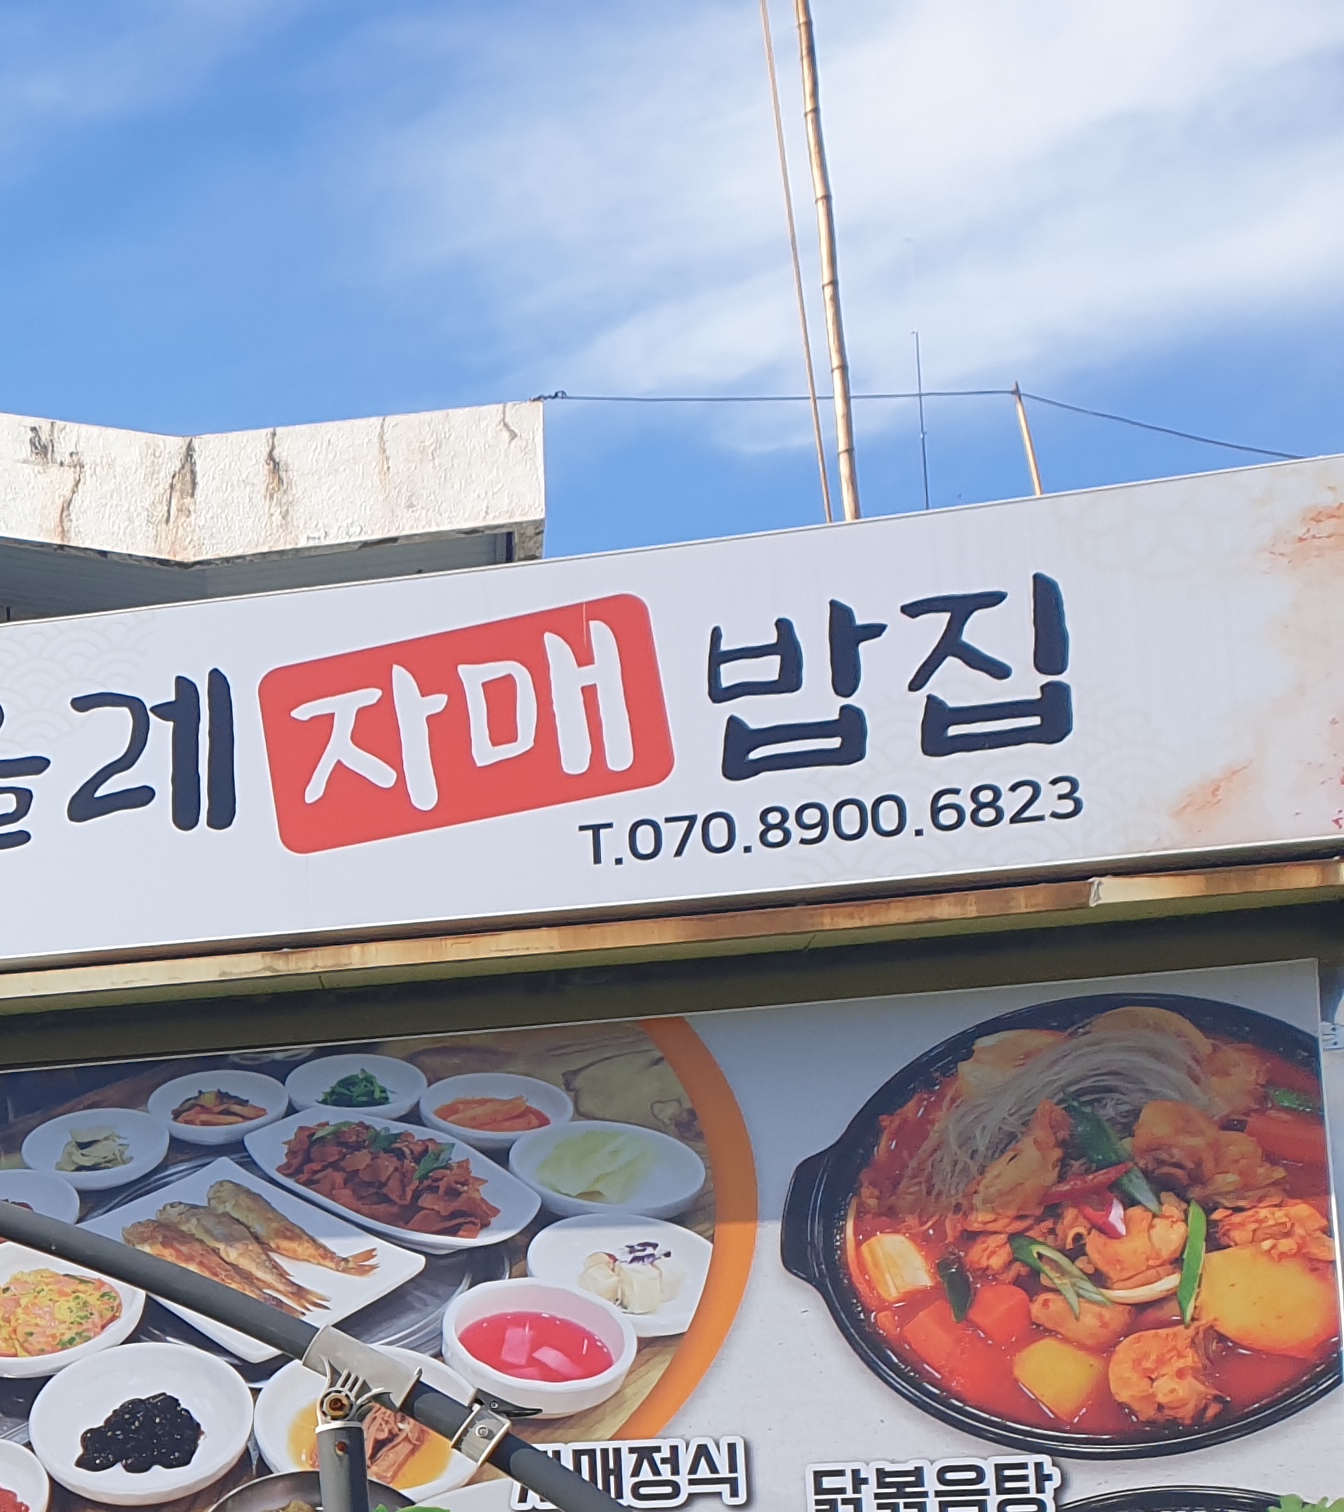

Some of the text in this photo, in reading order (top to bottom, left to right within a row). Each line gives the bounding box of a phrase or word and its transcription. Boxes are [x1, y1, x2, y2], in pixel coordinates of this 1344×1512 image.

[291, 620, 633, 811] 자매
[708, 572, 1073, 781] 밥집
[579, 776, 1084, 866] T.070.8900.6823
